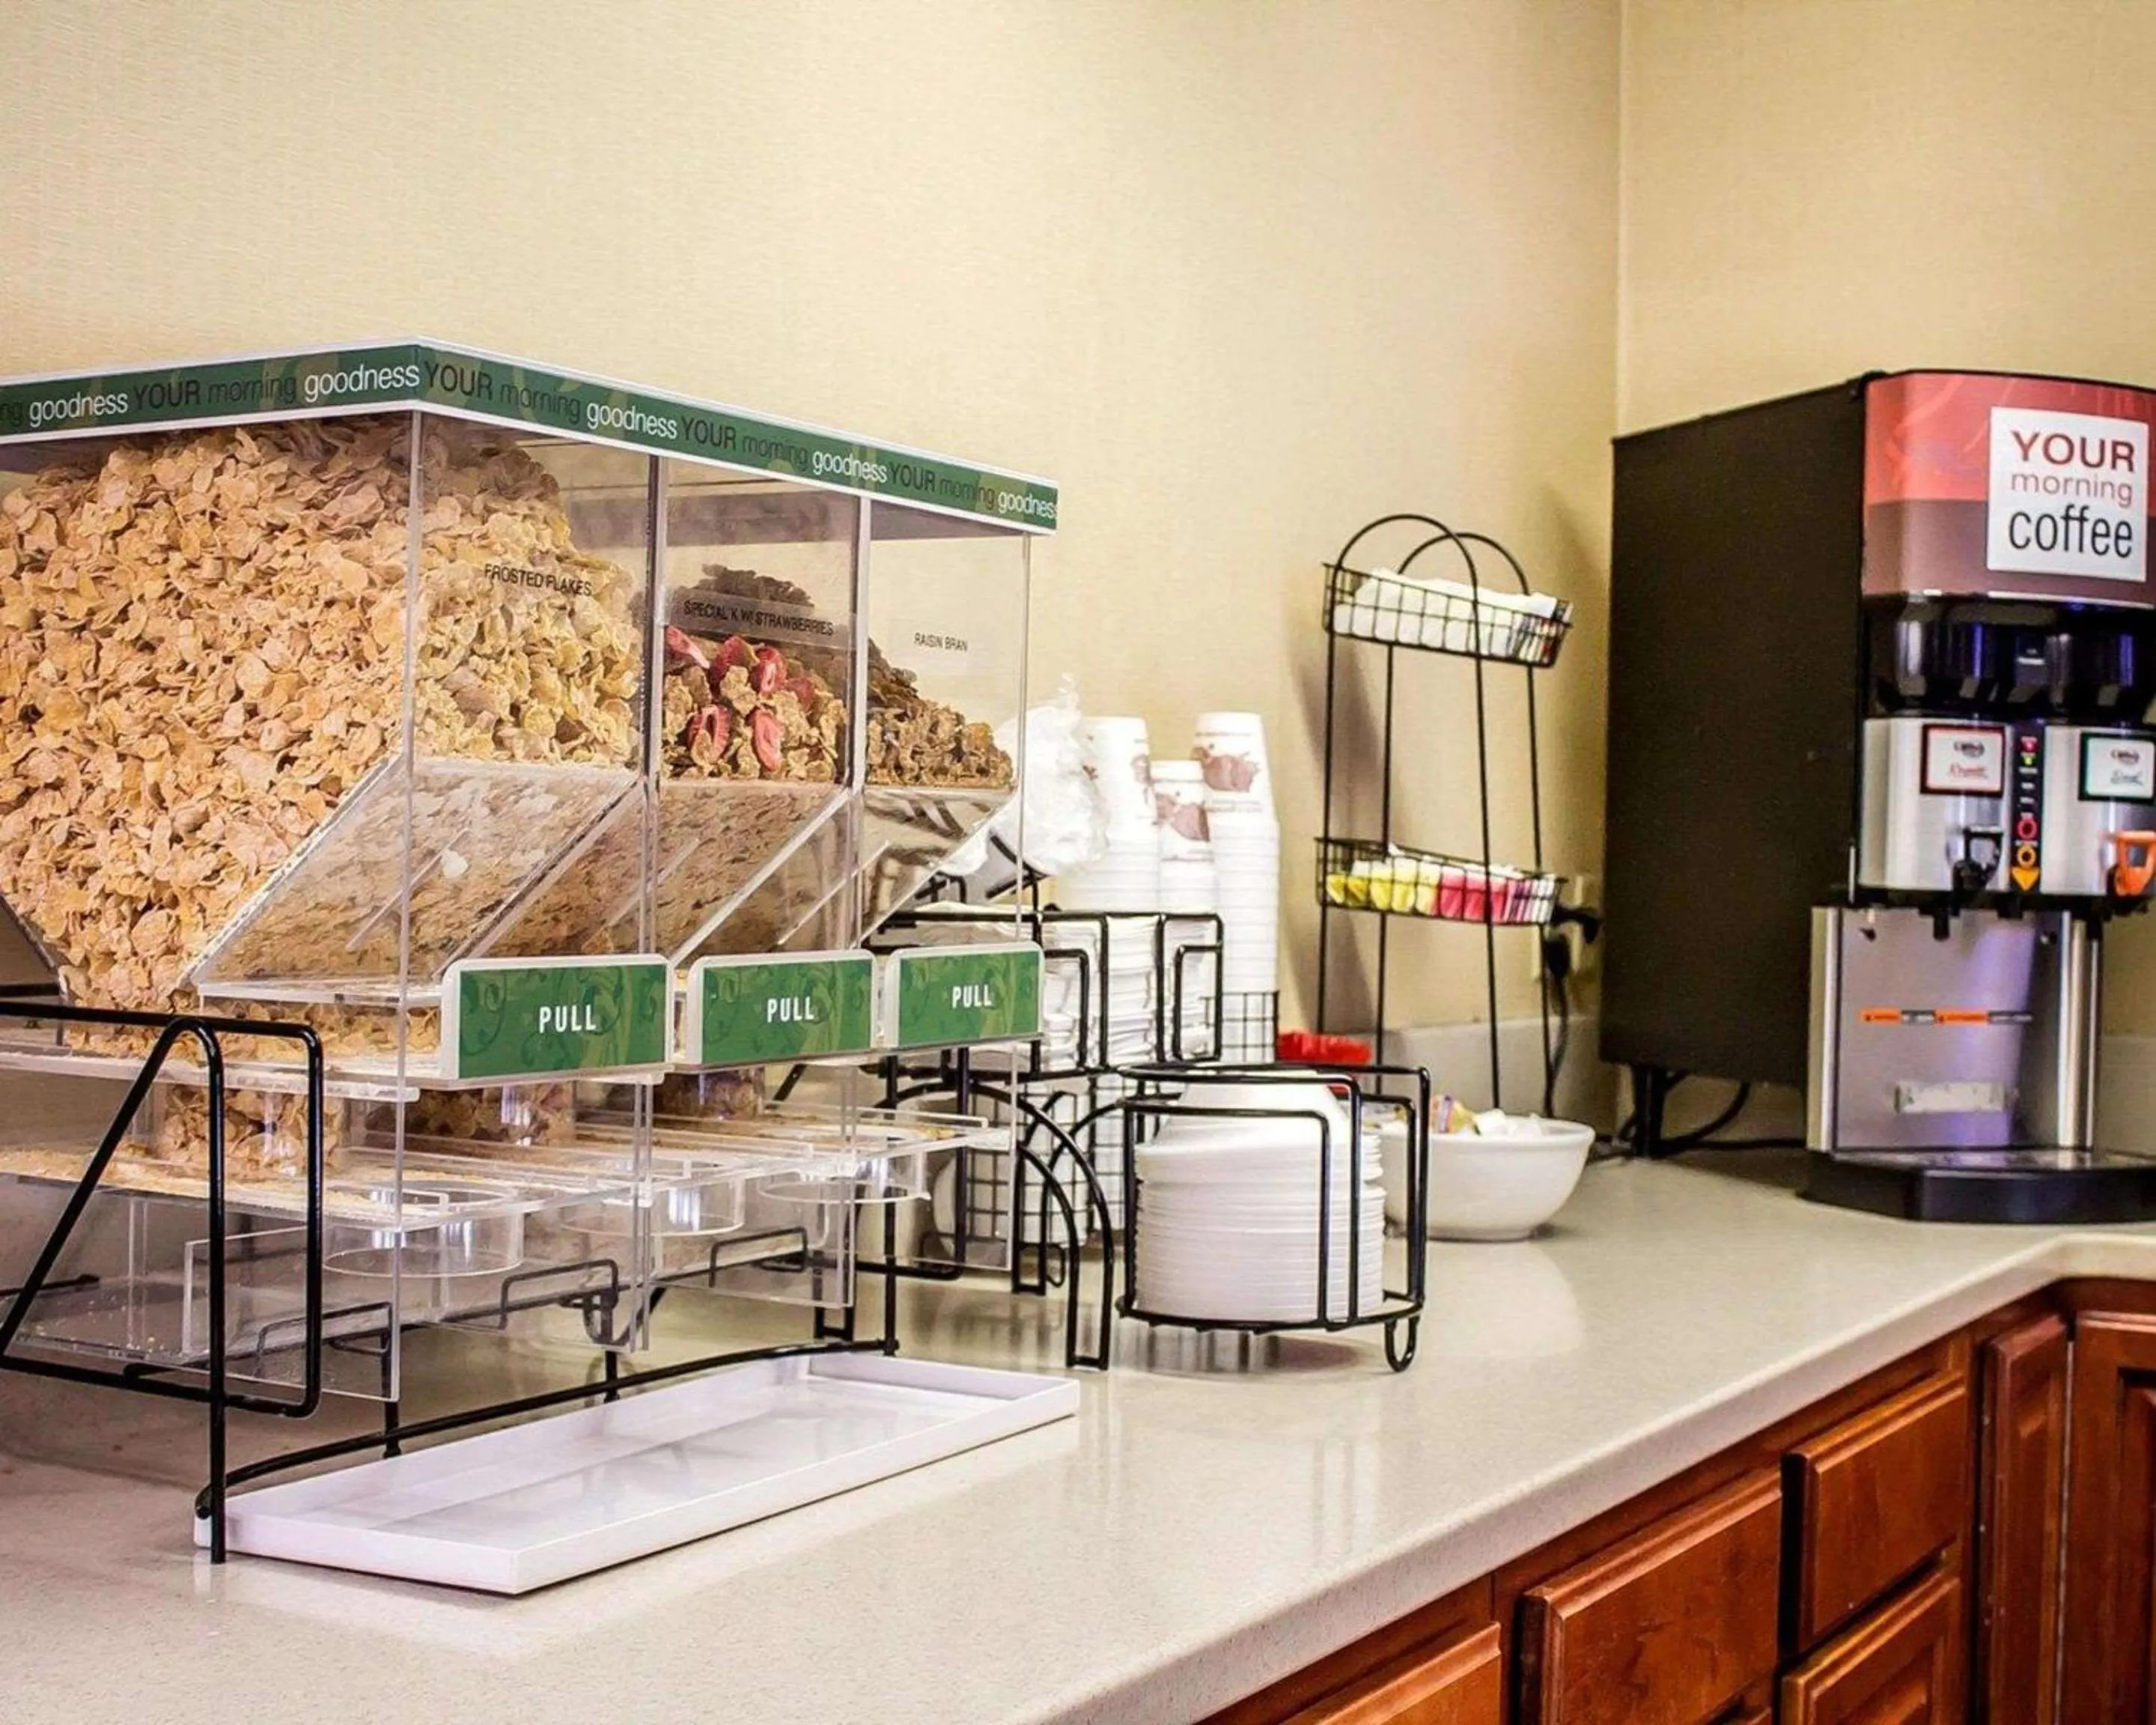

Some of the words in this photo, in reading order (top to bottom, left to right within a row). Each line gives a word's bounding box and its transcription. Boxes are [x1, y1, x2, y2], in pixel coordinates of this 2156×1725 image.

[29, 392, 128, 428] goodness
[133, 380, 201, 410] YOUR
[208, 372, 296, 404] morning
[304, 364, 420, 402] goodness
[424, 361, 493, 401] YOUR
[500, 383, 580, 425] morning
[587, 403, 677, 439] goodness
[681, 416, 737, 451] YOUR
[742, 435, 808, 471] morning
[812, 450, 887, 483] goodness
[889, 462, 935, 493] YOUR
[940, 478, 995, 510] morning
[2011, 429, 2136, 473] YOUR
[2012, 472, 2134, 509] morning
[2009, 503, 2133, 559] coffee
[484, 563, 543, 588] FROSTED
[546, 574, 592, 597] FLAKES
[683, 600, 727, 621] SPECIAL
[756, 611, 835, 636] STRAWBERRIES
[913, 632, 943, 648] RAISIN
[945, 636, 967, 652] BRAN
[767, 996, 814, 1023] PULL
[952, 985, 992, 1008] PULL
[540, 1004, 597, 1033] PULL
